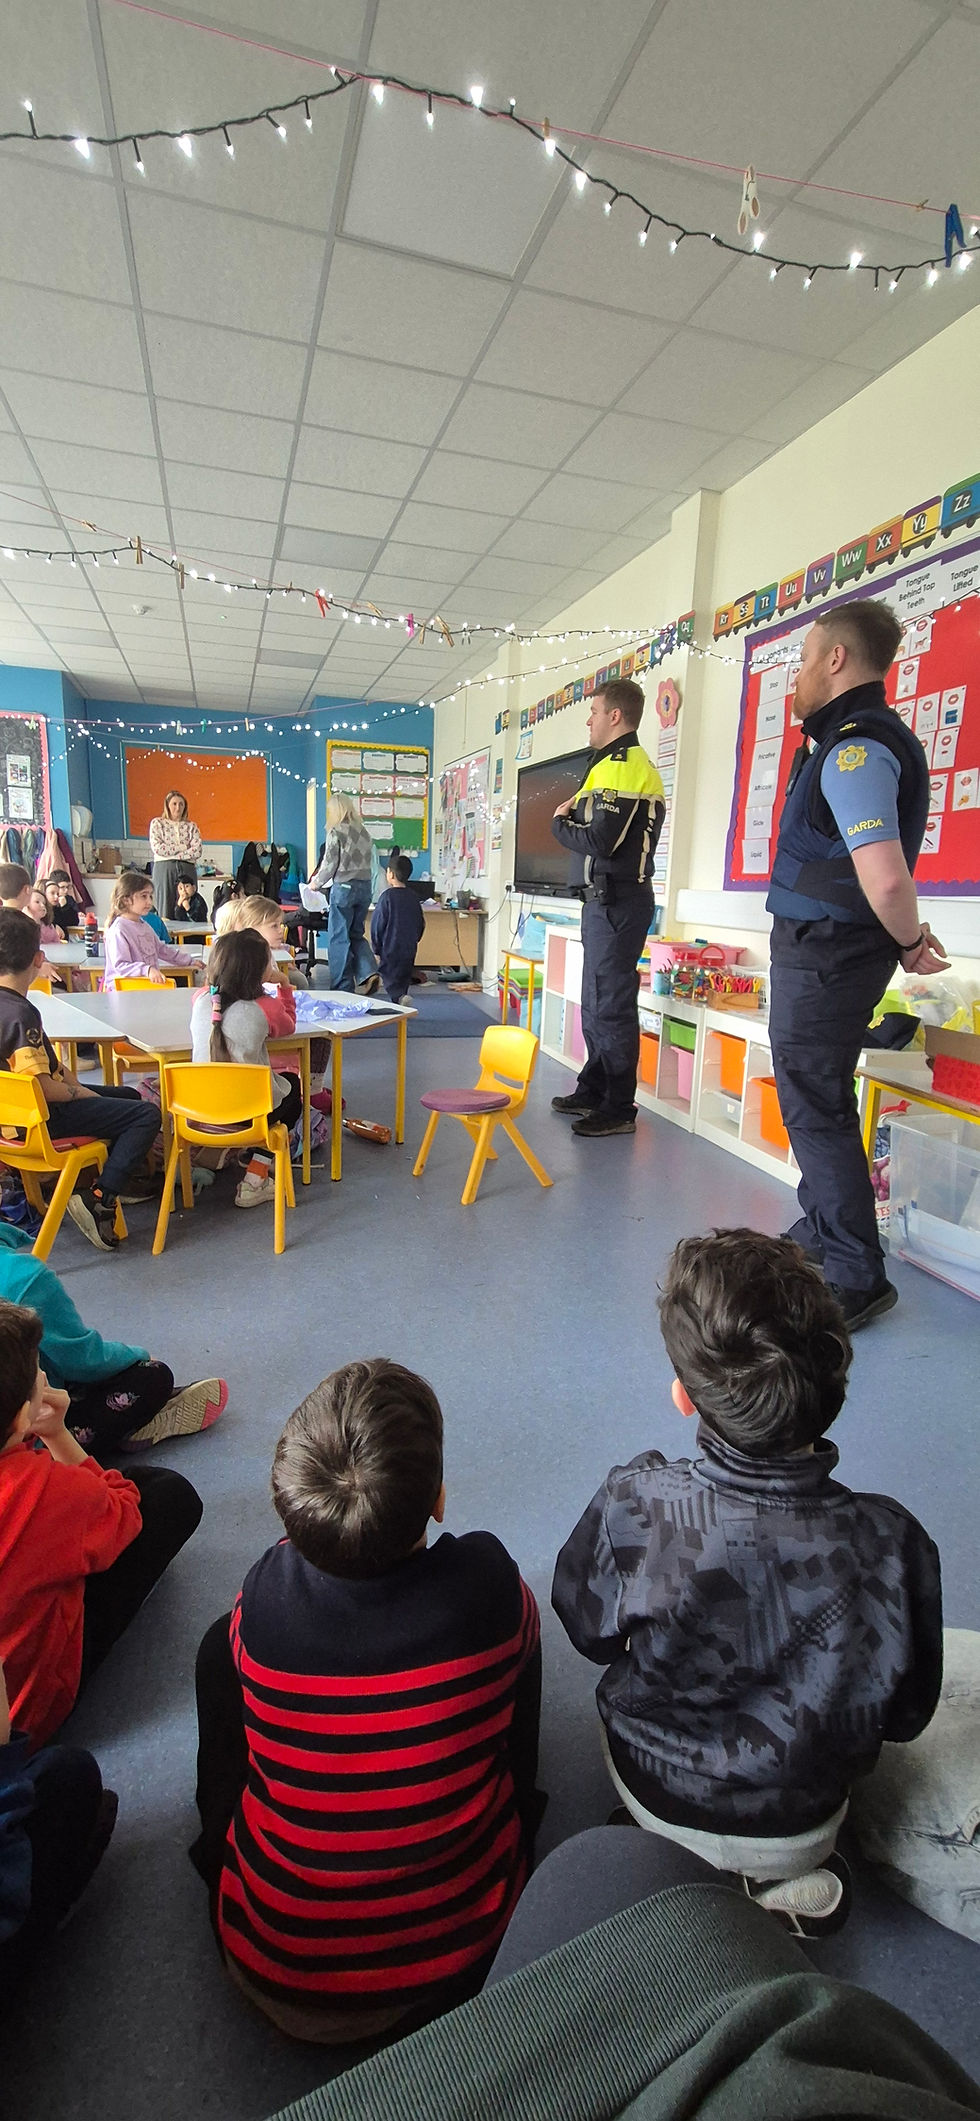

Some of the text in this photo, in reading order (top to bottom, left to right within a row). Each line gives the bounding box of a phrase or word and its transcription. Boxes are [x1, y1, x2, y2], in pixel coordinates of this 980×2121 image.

[740, 603, 749, 616] Ss
[813, 567, 827, 583] Vv
[842, 549, 862, 567] Ww
[876, 534, 892, 551] Xx
[953, 494, 971, 512] Zz
[906, 572, 930, 588] Tongue
[951, 565, 979, 581] Tongue
[899, 586, 922, 602] Behind
[923, 582, 936, 592] Top
[953, 577, 973, 592] Lifted
[907, 597, 925, 610] Teeth
[847, 818, 884, 836] GARDA
